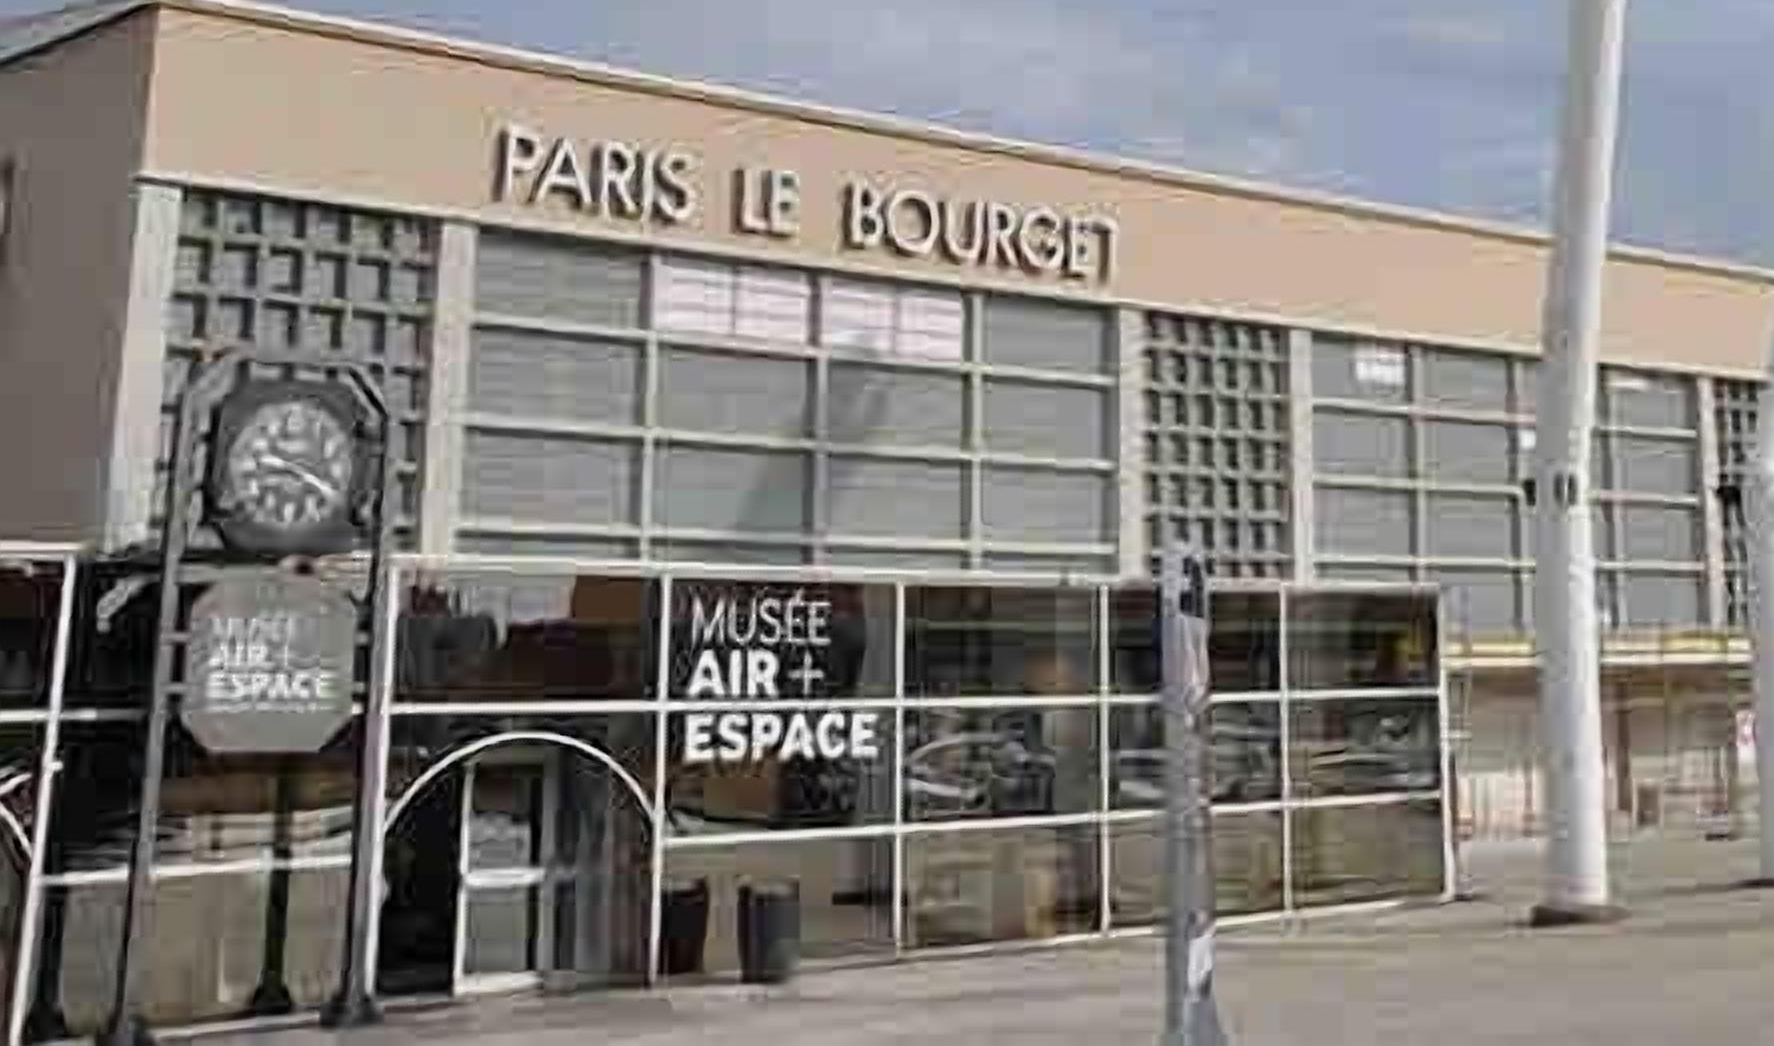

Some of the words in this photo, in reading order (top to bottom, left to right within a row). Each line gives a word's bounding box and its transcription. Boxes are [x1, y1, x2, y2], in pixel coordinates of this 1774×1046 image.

[496, 124, 695, 221] PARIS
[735, 167, 800, 235] LE
[843, 179, 1120, 287] BOURGET
[690, 588, 832, 645] MUSÉE
[687, 649, 779, 696] AIR
[684, 712, 879, 762] ESPACE
